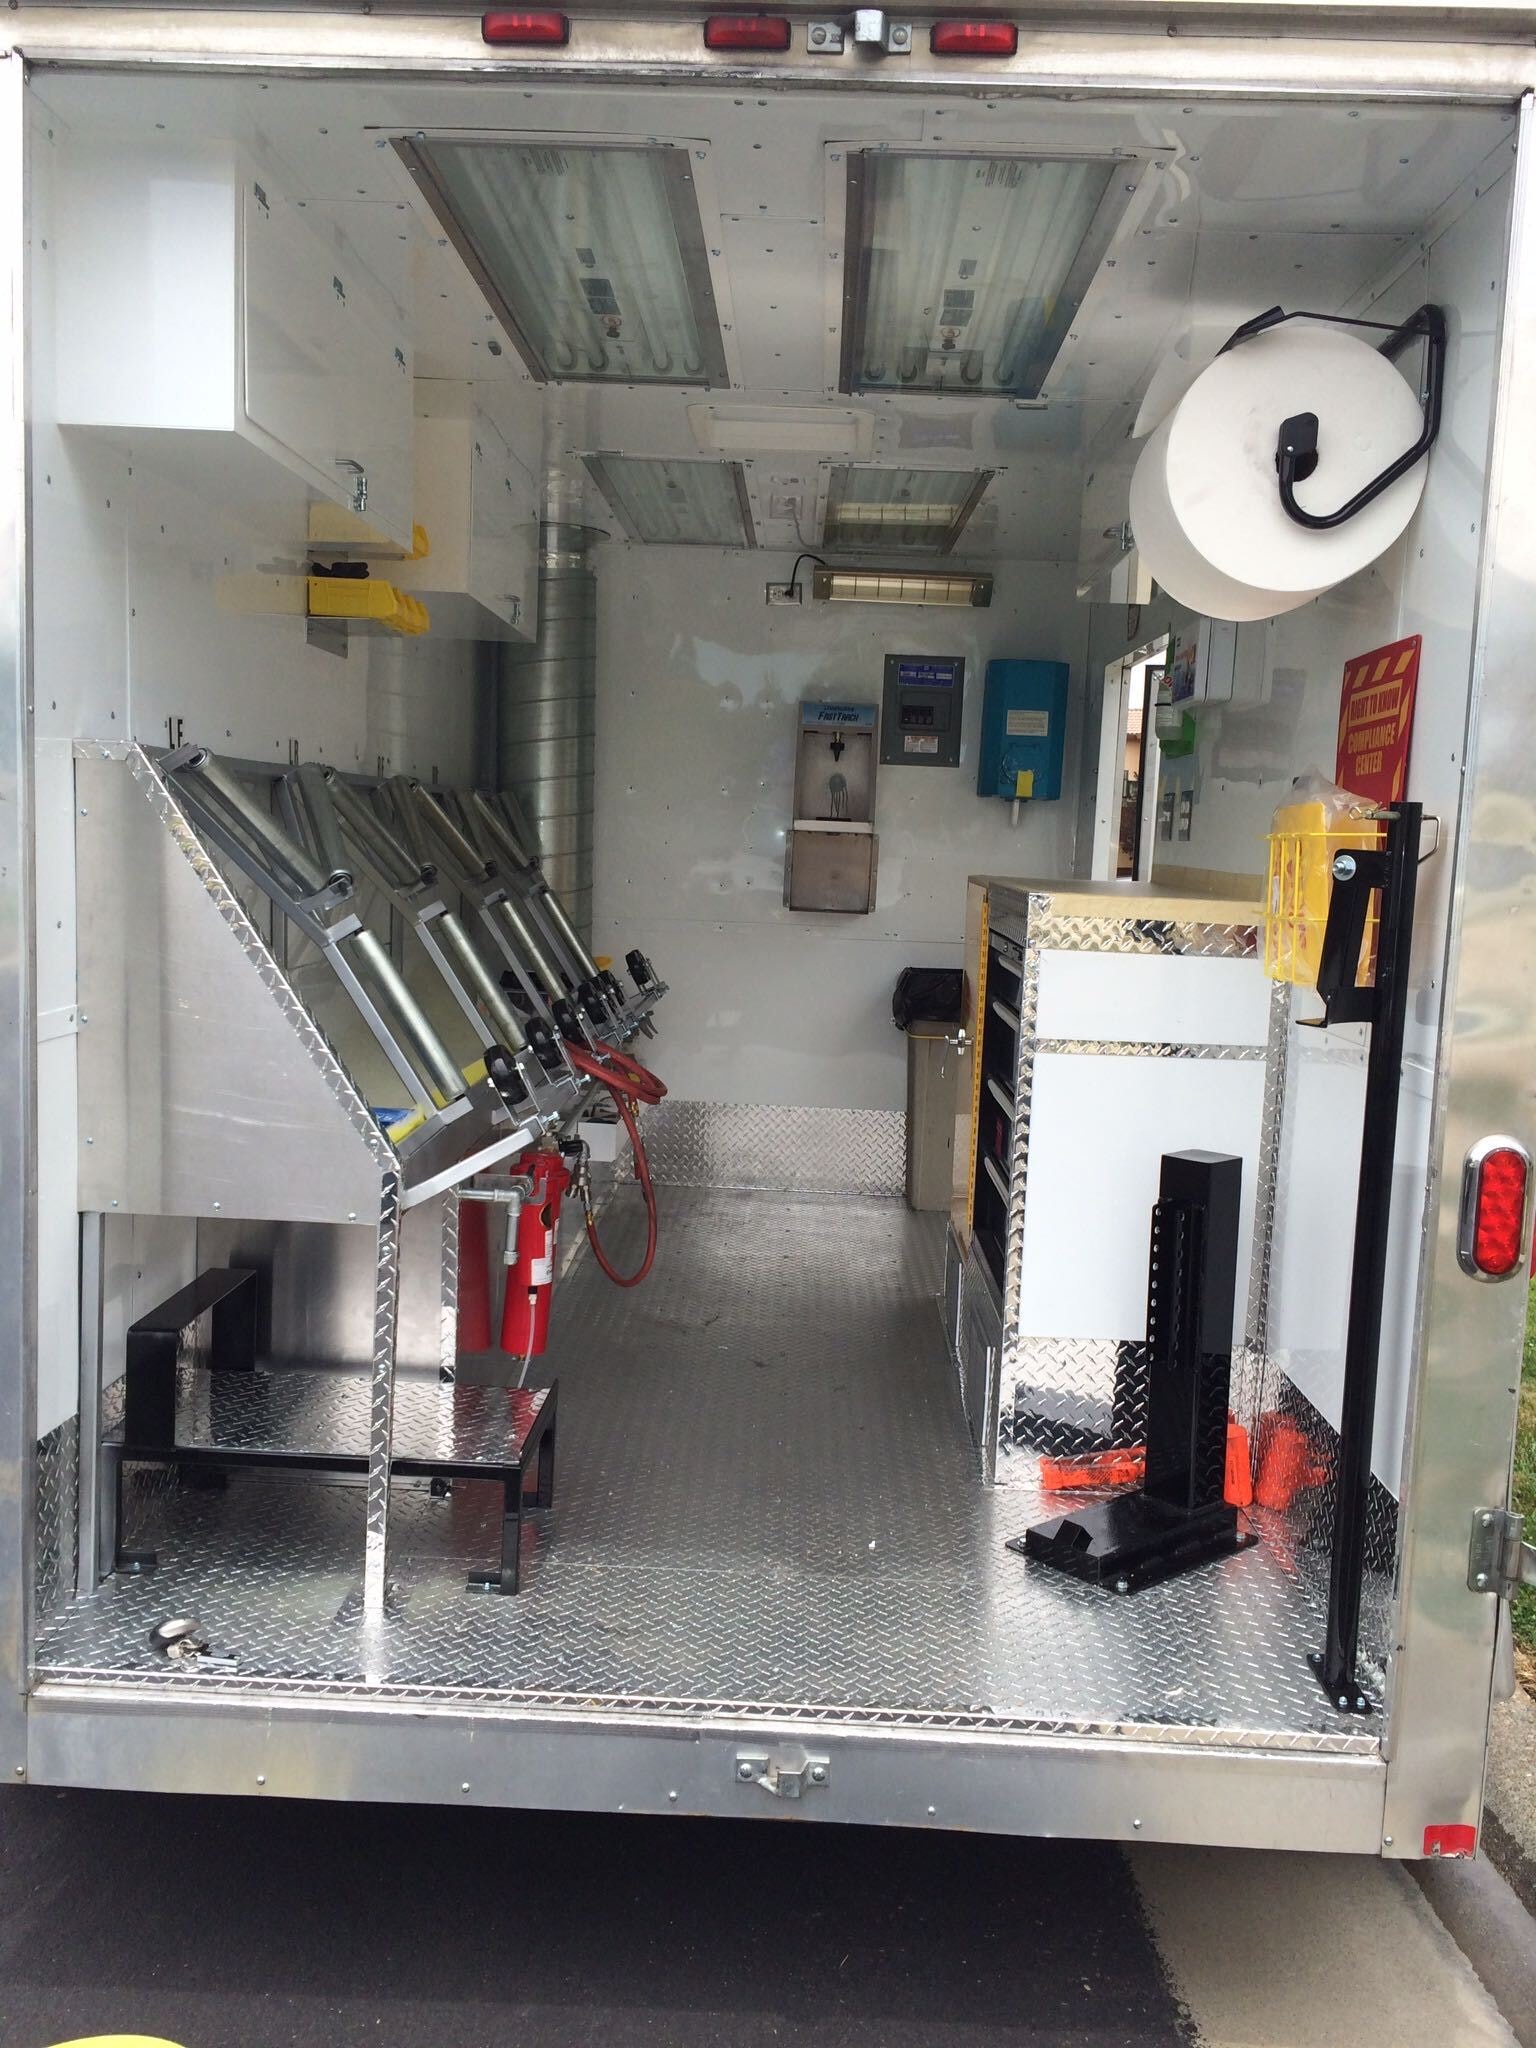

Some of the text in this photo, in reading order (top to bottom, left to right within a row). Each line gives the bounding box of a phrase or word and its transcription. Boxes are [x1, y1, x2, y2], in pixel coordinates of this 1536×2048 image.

[1351, 687, 1400, 720] RIGHT TO KNOW
[169, 717, 183, 749] LF
[1348, 722, 1396, 753] COMPLIANCE
[1356, 750, 1382, 776] CENTER
